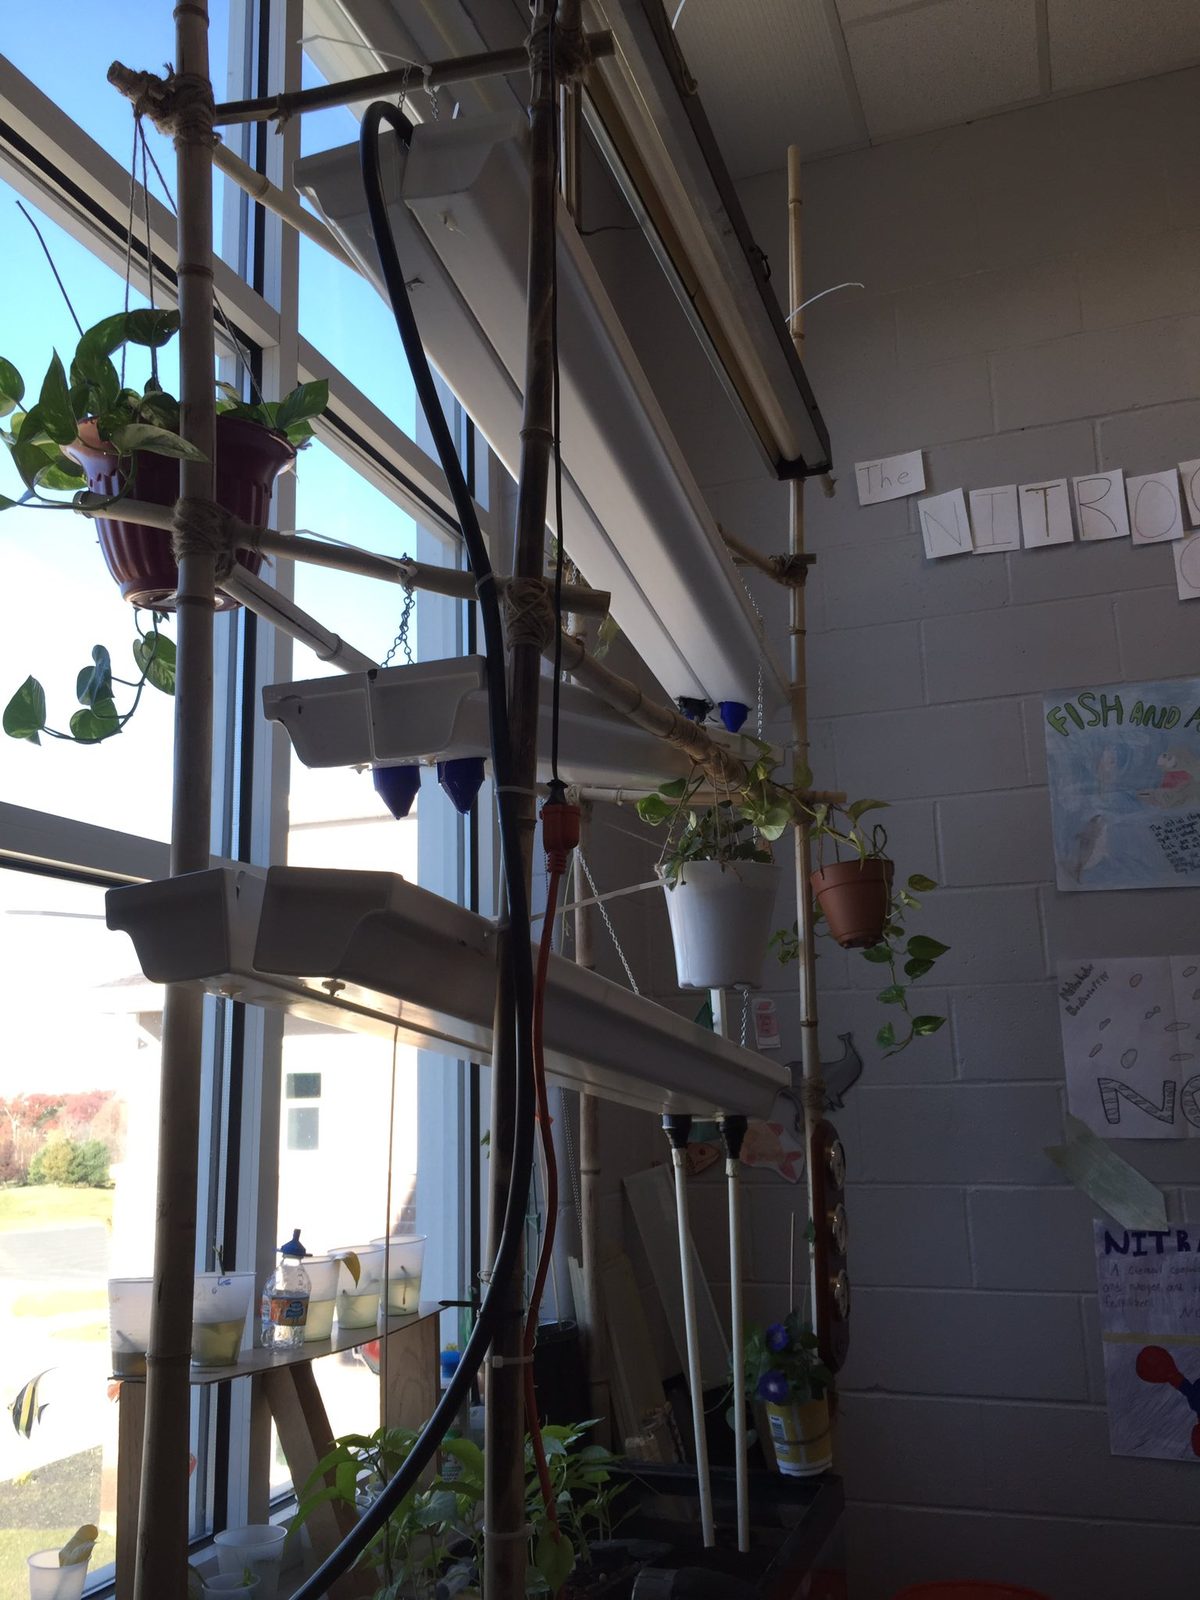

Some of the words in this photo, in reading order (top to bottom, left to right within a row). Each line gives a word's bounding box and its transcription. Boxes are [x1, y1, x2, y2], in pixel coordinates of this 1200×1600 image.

[858, 462, 910, 495] The
[1047, 692, 1124, 736] FISH
[1128, 700, 1182, 730] AND
